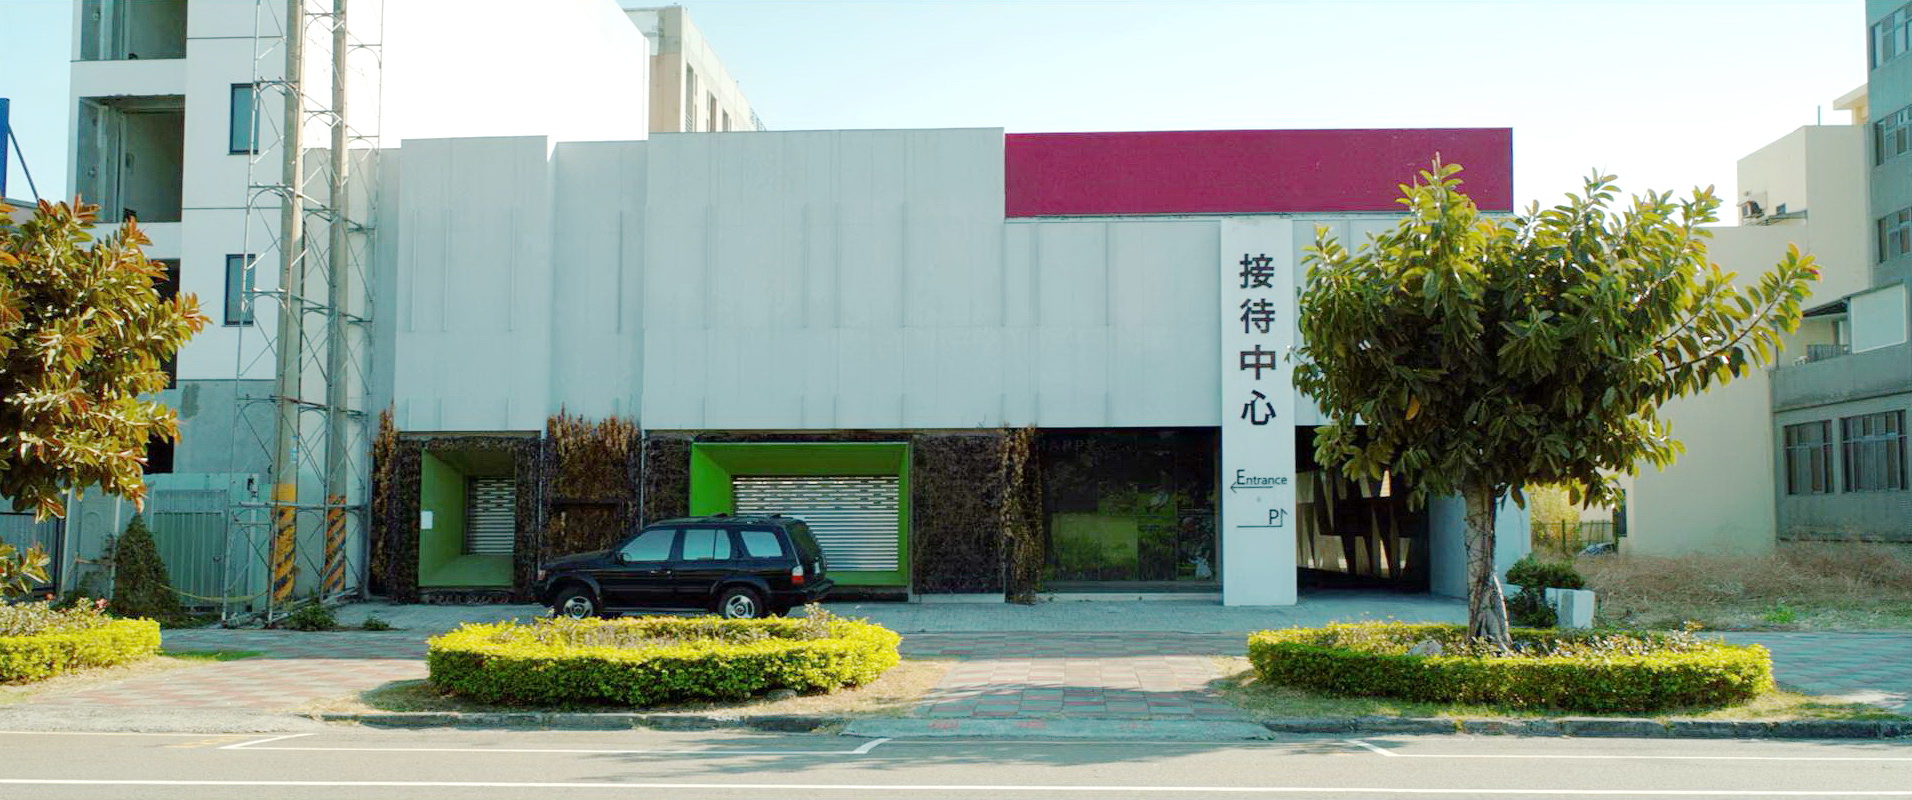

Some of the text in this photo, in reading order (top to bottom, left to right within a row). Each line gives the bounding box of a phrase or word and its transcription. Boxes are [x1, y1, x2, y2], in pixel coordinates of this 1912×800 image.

[1239, 253, 1277, 426] 接待中心
[1236, 469, 1288, 485] Entrance
[1269, 509, 1279, 525] P
